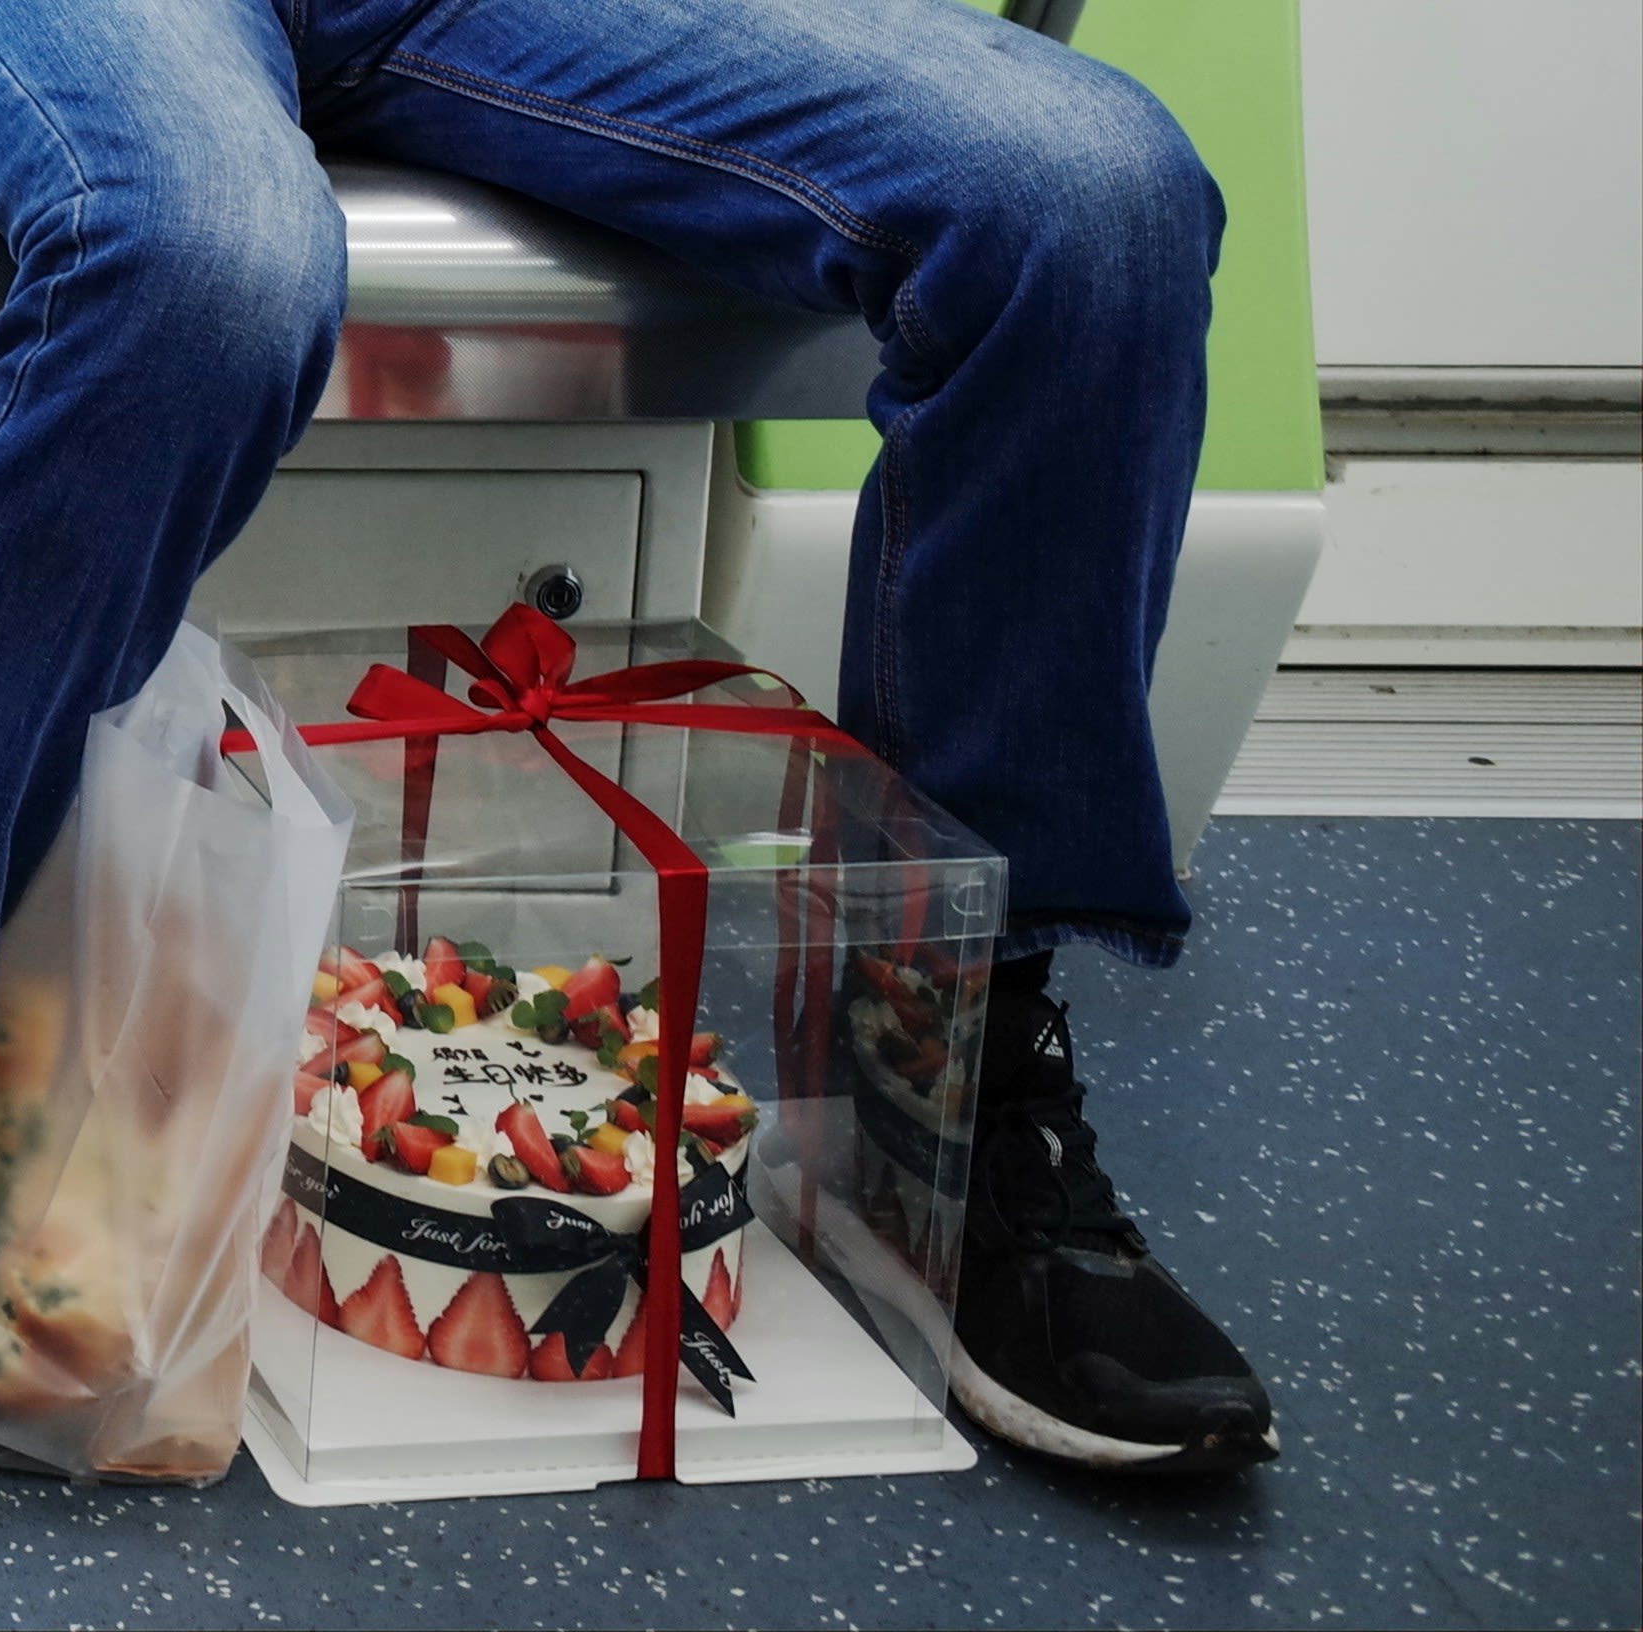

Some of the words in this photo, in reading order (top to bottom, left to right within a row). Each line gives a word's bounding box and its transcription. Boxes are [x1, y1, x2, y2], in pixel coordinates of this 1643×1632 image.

[681, 1199, 705, 1229] yo
[401, 1218, 464, 1252] Just
[462, 1231, 505, 1254] for
[680, 1332, 731, 1384] Just
